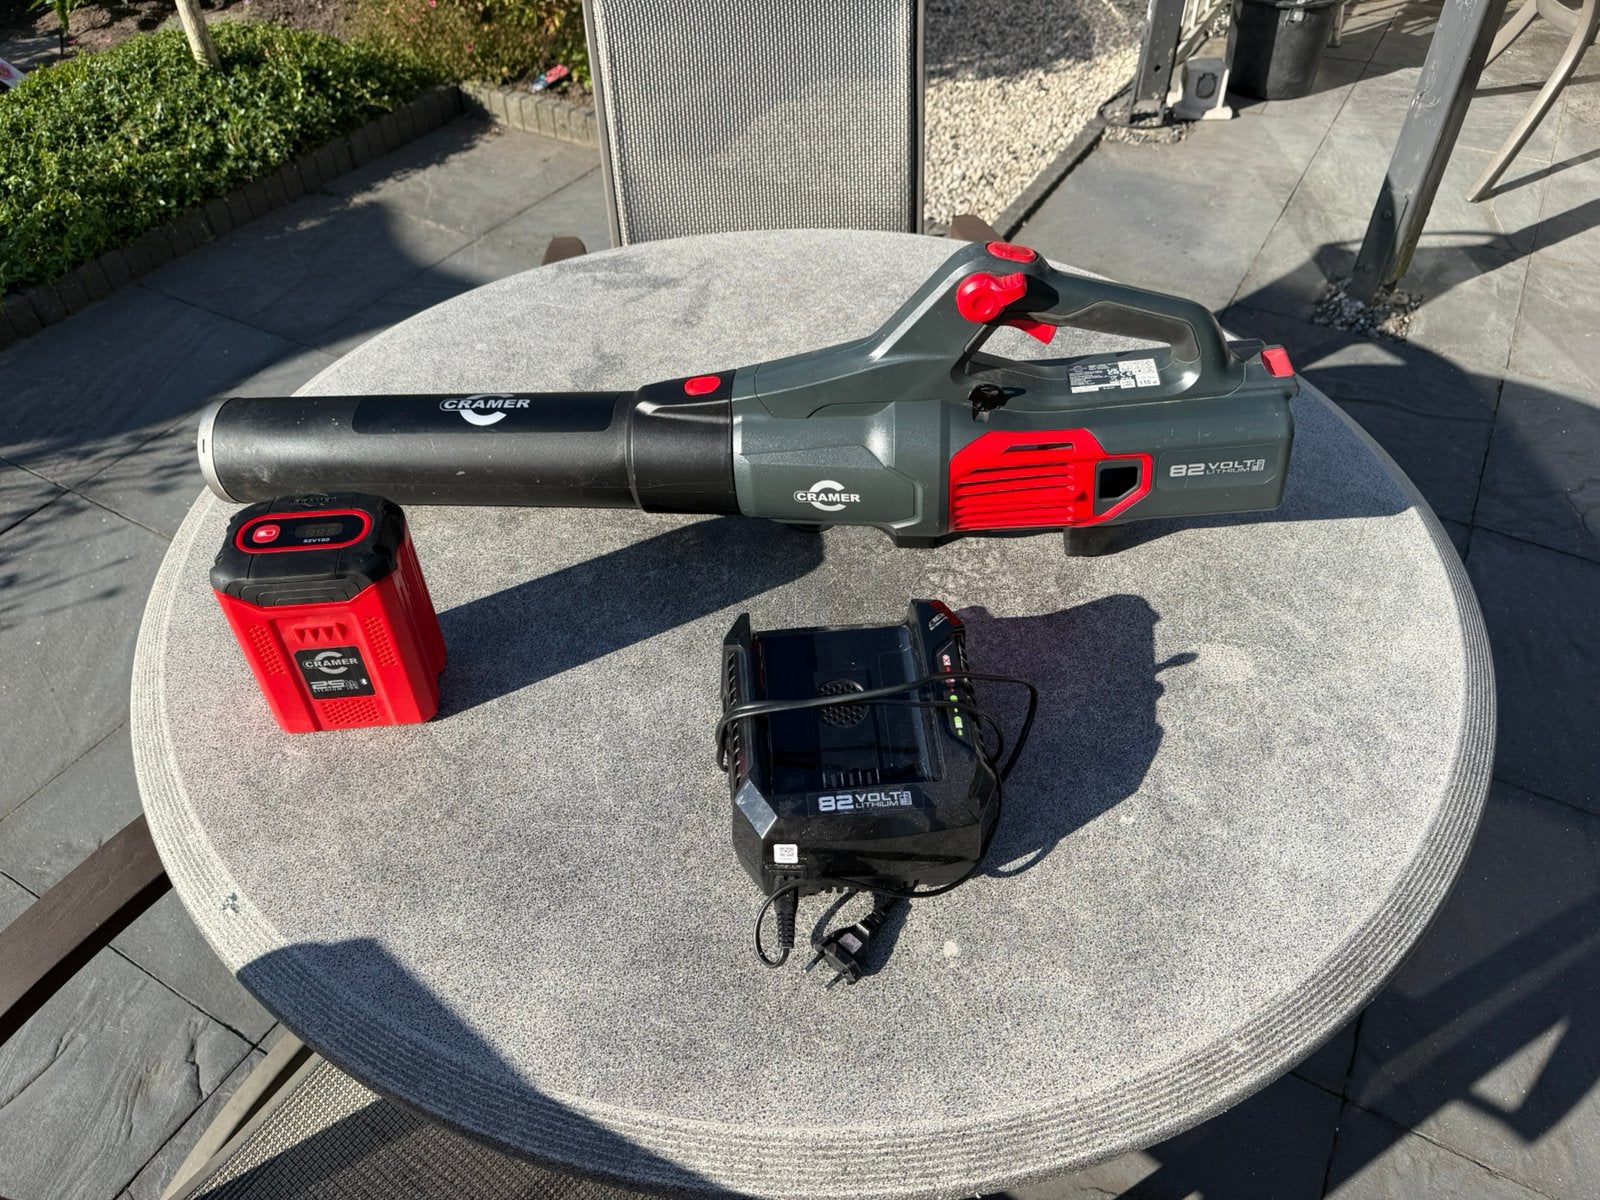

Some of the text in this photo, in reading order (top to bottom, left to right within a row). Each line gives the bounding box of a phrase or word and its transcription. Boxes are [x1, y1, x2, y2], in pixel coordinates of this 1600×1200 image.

[1169, 463, 1205, 477] 82
[1207, 459, 1256, 469] VOLT
[1206, 467, 1250, 475] LITHIUM
[818, 795, 854, 811] 82
[855, 791, 901, 802] VOLT
[855, 800, 899, 809] LITHIUM
